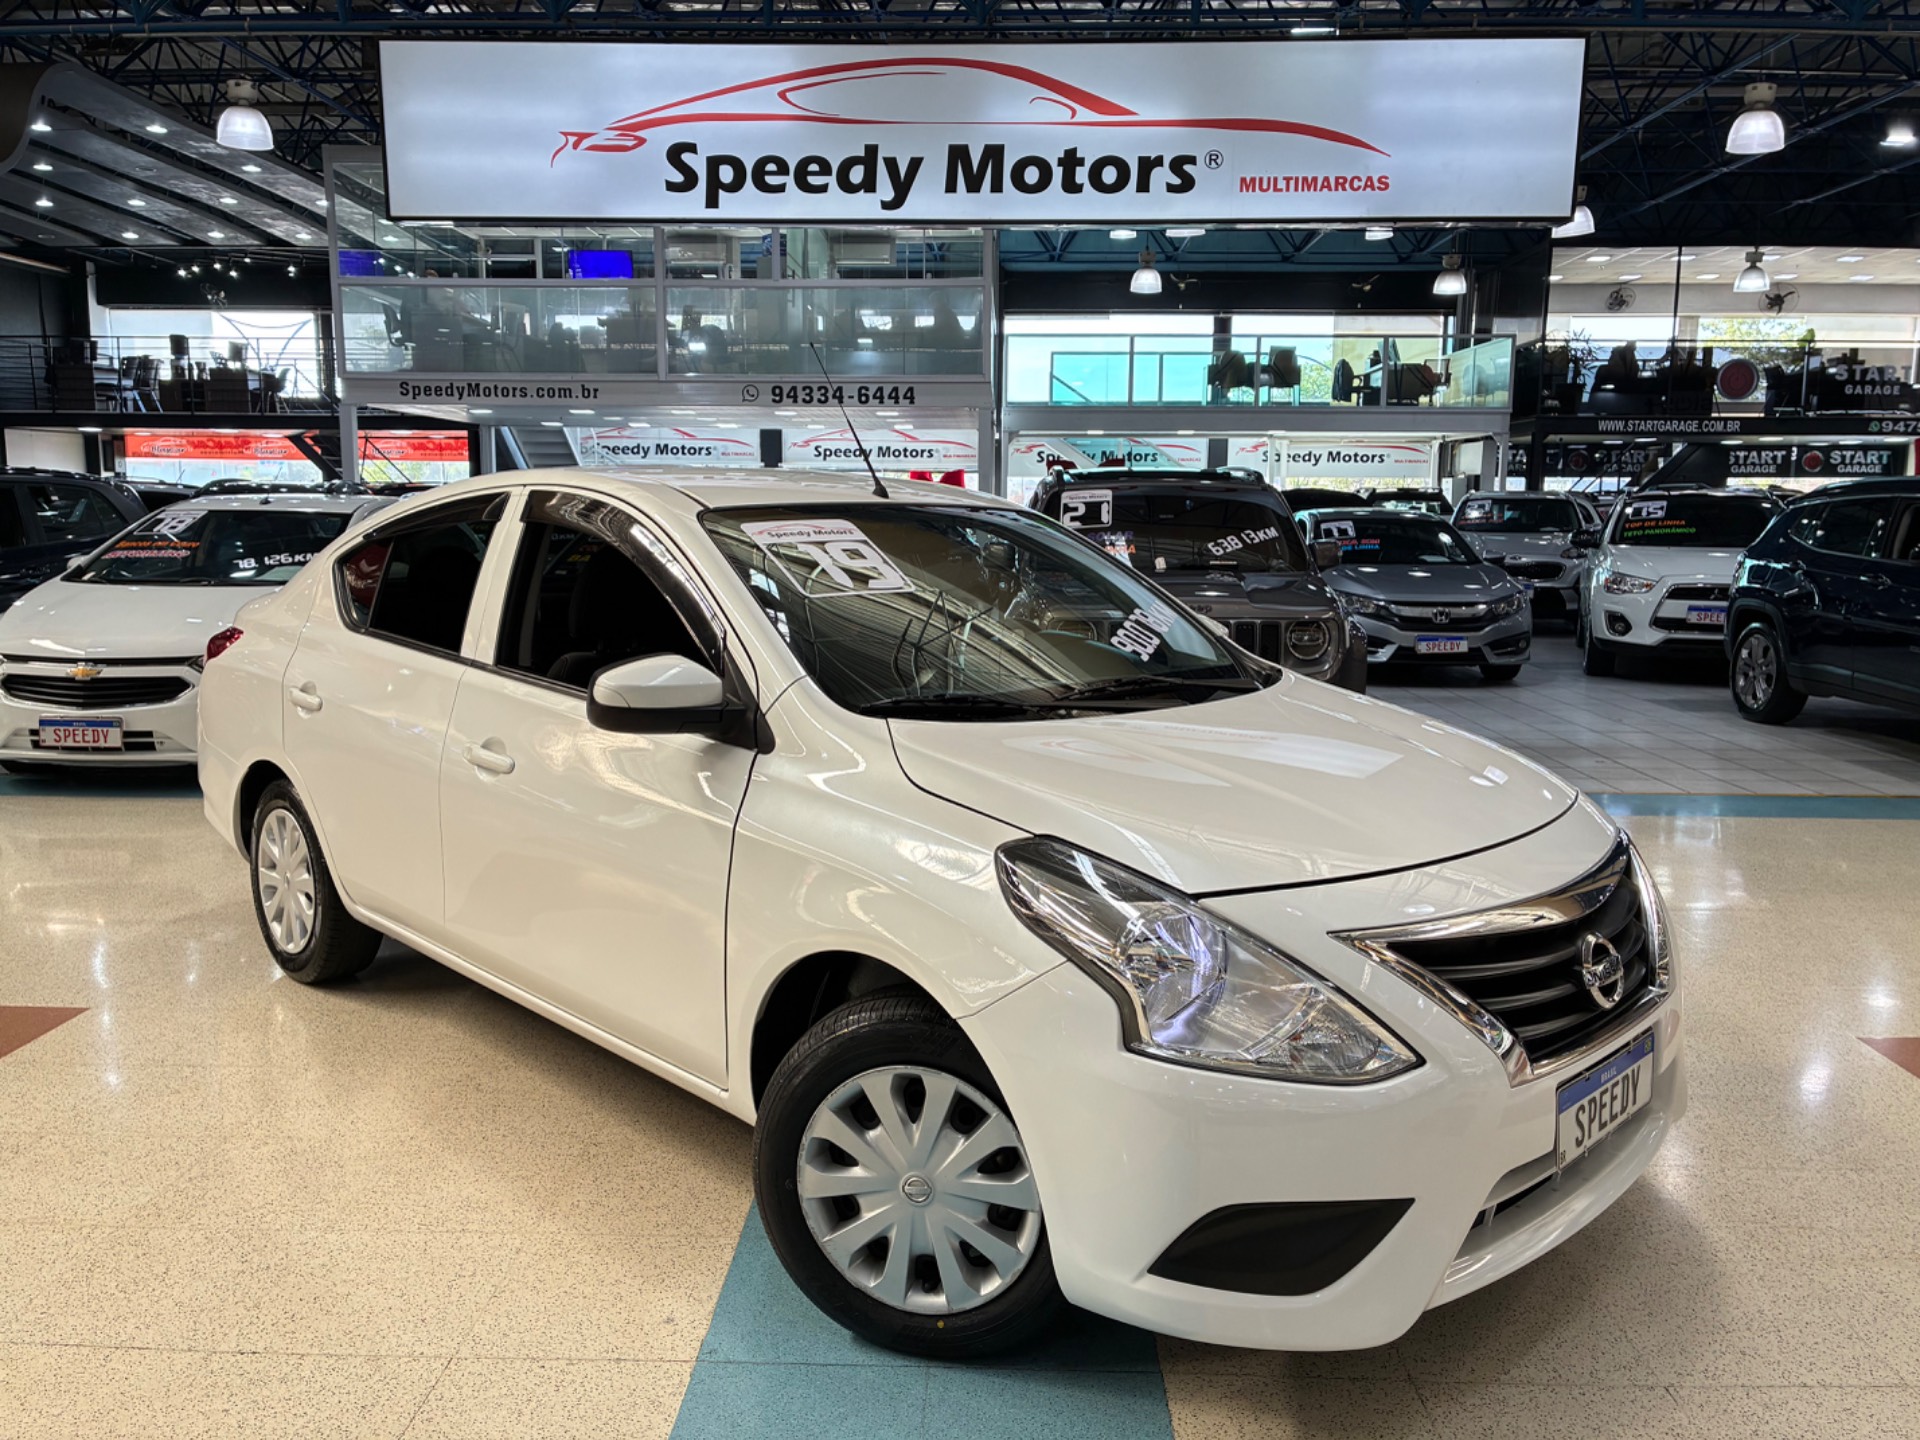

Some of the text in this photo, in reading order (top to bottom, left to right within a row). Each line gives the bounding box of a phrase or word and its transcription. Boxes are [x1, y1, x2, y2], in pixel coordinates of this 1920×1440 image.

[664, 140, 925, 211] Speedy
[1239, 175, 1391, 193] MULTIMARCAS
[399, 381, 600, 401] SpeedyMotors.com.br
[770, 385, 916, 405] 94334-6444
[1844, 384, 1901, 395] GARAGE
[1598, 420, 1741, 432] WWW.STARTGARAGE.COM.BR
[655, 443, 713, 456] Motors
[813, 445, 934, 461] Speedy Motors
[1327, 451, 1386, 463] Motors
[1829, 451, 1892, 464] START
[1730, 465, 1777, 474] GARAGE
[1837, 464, 1882, 473] GARAGE
[767, 529, 812, 539] Speedy
[1425, 641, 1461, 652] SPEEDY
[53, 728, 109, 744] SPEEDY
[1574, 1063, 1642, 1149] SPEEDY
